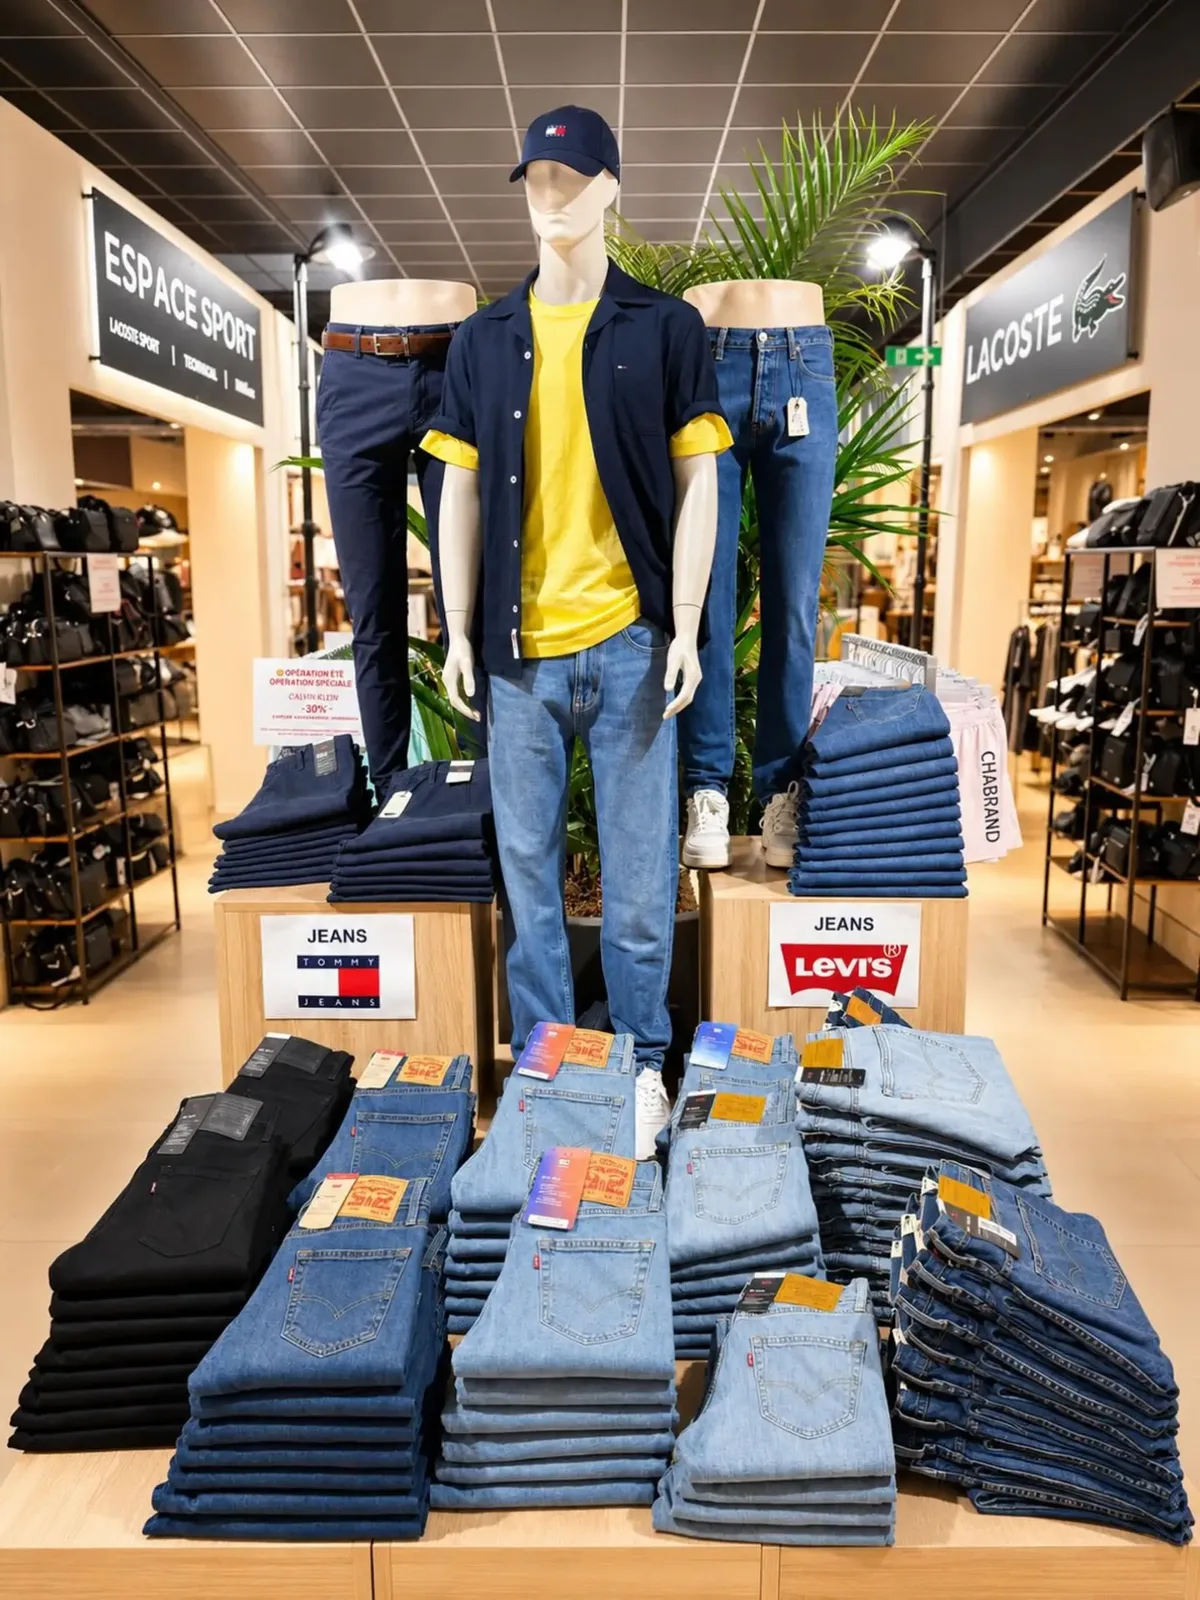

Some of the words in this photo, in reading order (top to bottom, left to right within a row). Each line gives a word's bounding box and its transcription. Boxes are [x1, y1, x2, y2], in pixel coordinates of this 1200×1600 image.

[104, 230, 198, 330] ESPACE
[201, 296, 256, 361] SPORT
[109, 316, 139, 346] LACOSTE
[138, 331, 160, 355] SPORT
[965, 294, 1064, 385] LACOSTE
[980, 750, 1001, 843] CHABRAND
[307, 928, 368, 944] JEANS
[814, 916, 875, 932] JEANS
[303, 958, 375, 967] TOMMY
[303, 998, 375, 1007] JEANS
